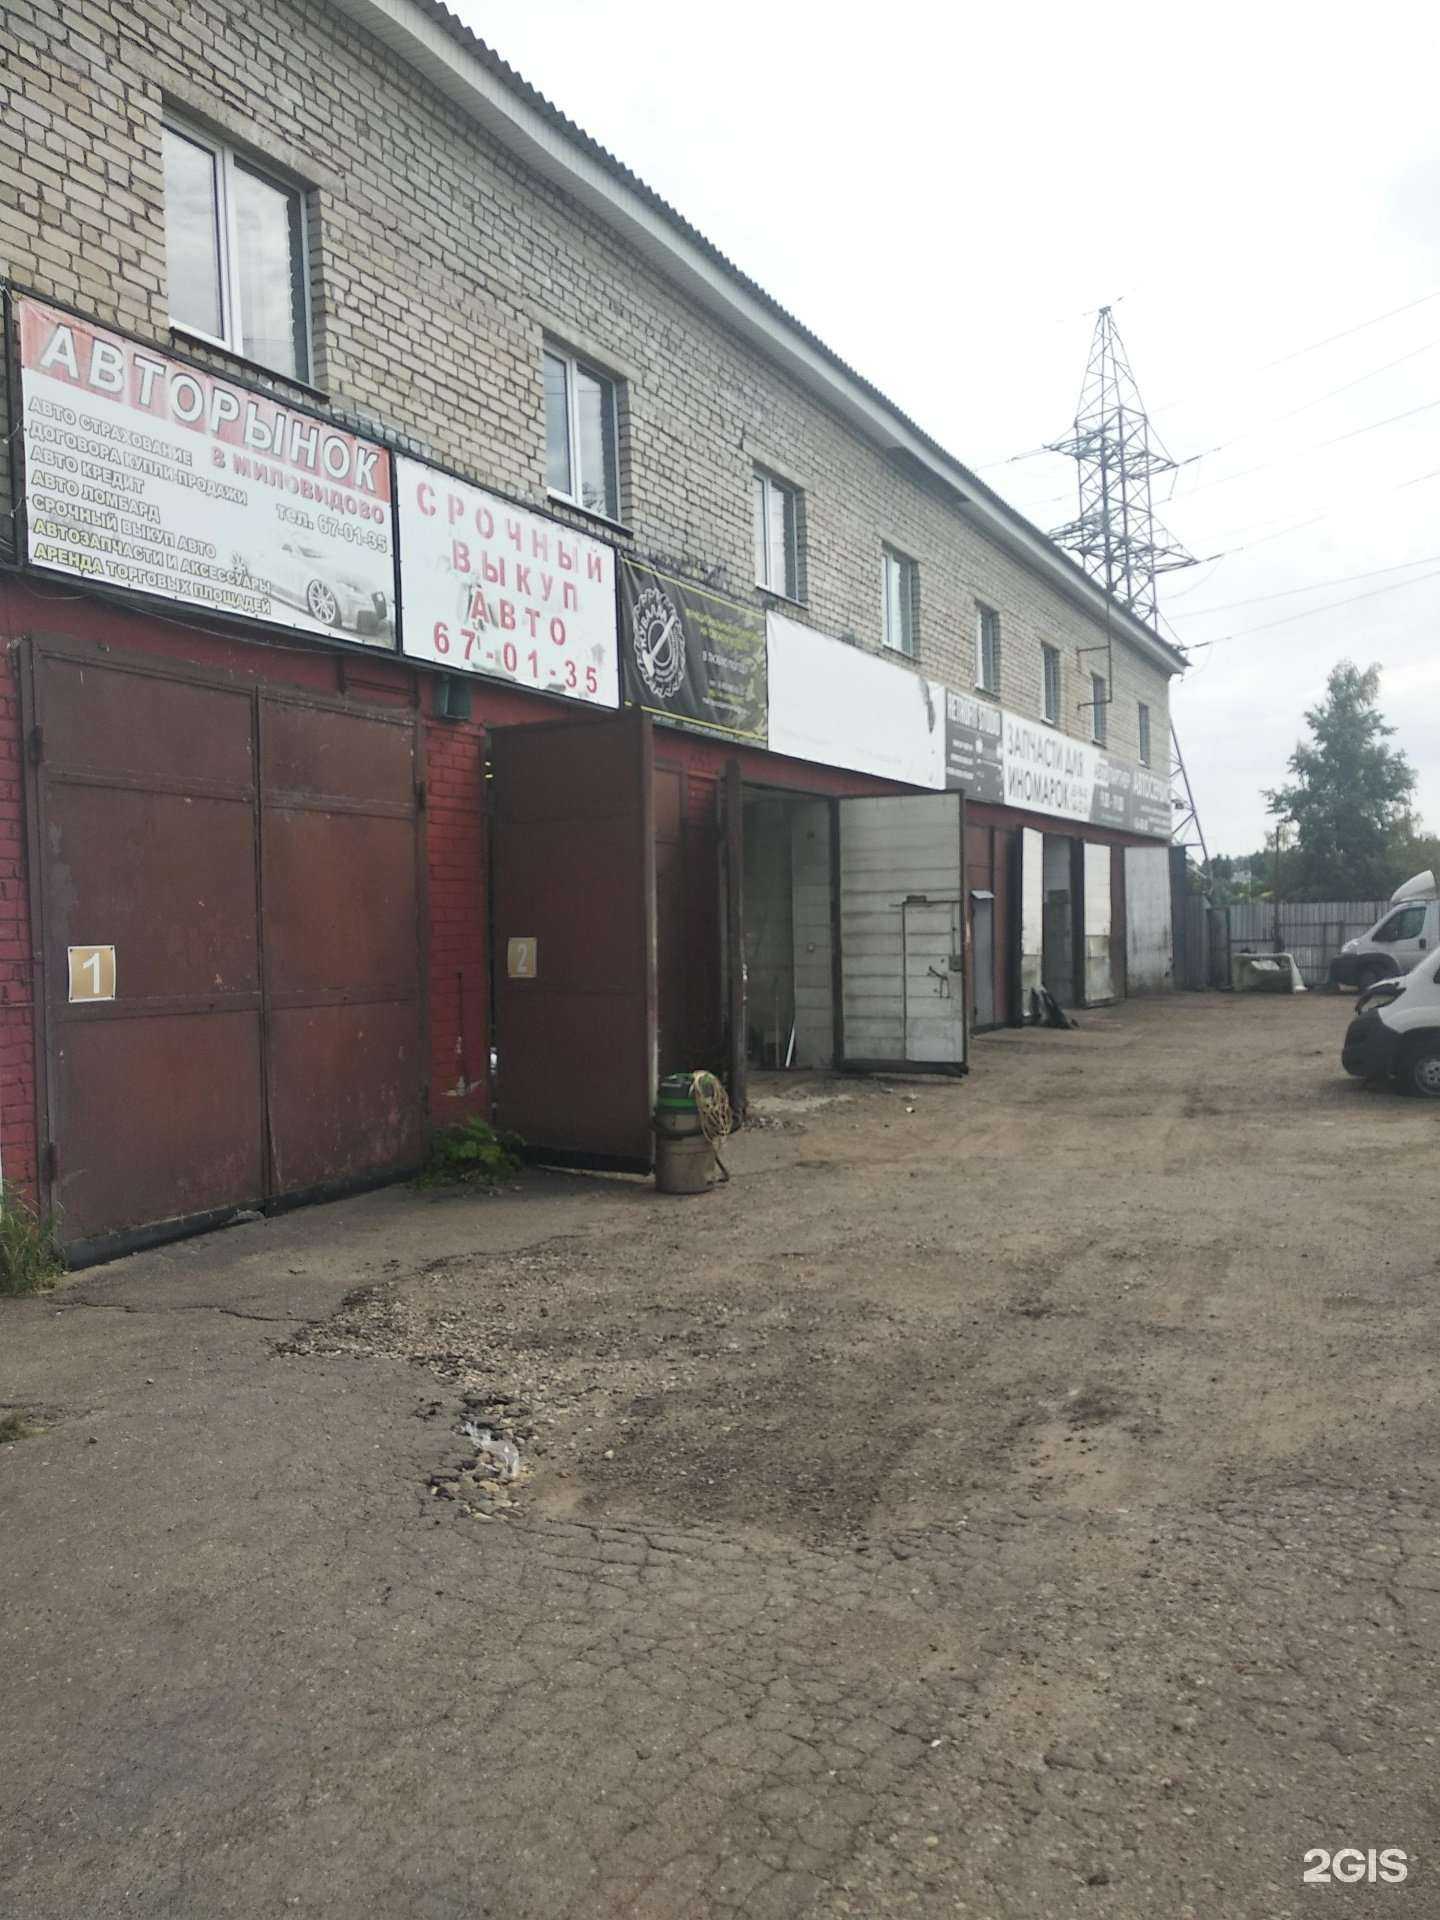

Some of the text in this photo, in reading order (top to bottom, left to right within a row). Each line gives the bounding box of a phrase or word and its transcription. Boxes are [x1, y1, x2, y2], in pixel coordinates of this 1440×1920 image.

[29, 397, 193, 466] АВТО СТРАХОВАНИЕ
[39, 322, 380, 493] АВТОРЫНОК
[29, 420, 121, 464] ДОГОВОРА
[30, 446, 145, 494] АВТО КРЕДИТ
[31, 469, 160, 523] АВТО ЛОМБАРД
[32, 493, 217, 560] СРОЧНЫЙ ВЫКУП АВТО
[33, 518, 272, 596] АВТОЗАПЧАСТИ И АКСЕССУАРЫ
[317, 513, 388, 553] 67-01-35
[416, 482, 603, 584] СРОЧНЫЙ
[34, 543, 272, 615] АРЕНДА ТОРГОВЫХ ПЛОЩАДЕЙ
[451, 540, 579, 612] ВЫКУП
[470, 590, 567, 646] АВТО
[433, 621, 599, 694] 67-01-35
[1007, 764, 1070, 810] ИНОМАРОК
[81, 952, 100, 994] 1
[516, 943, 529, 974] 2
